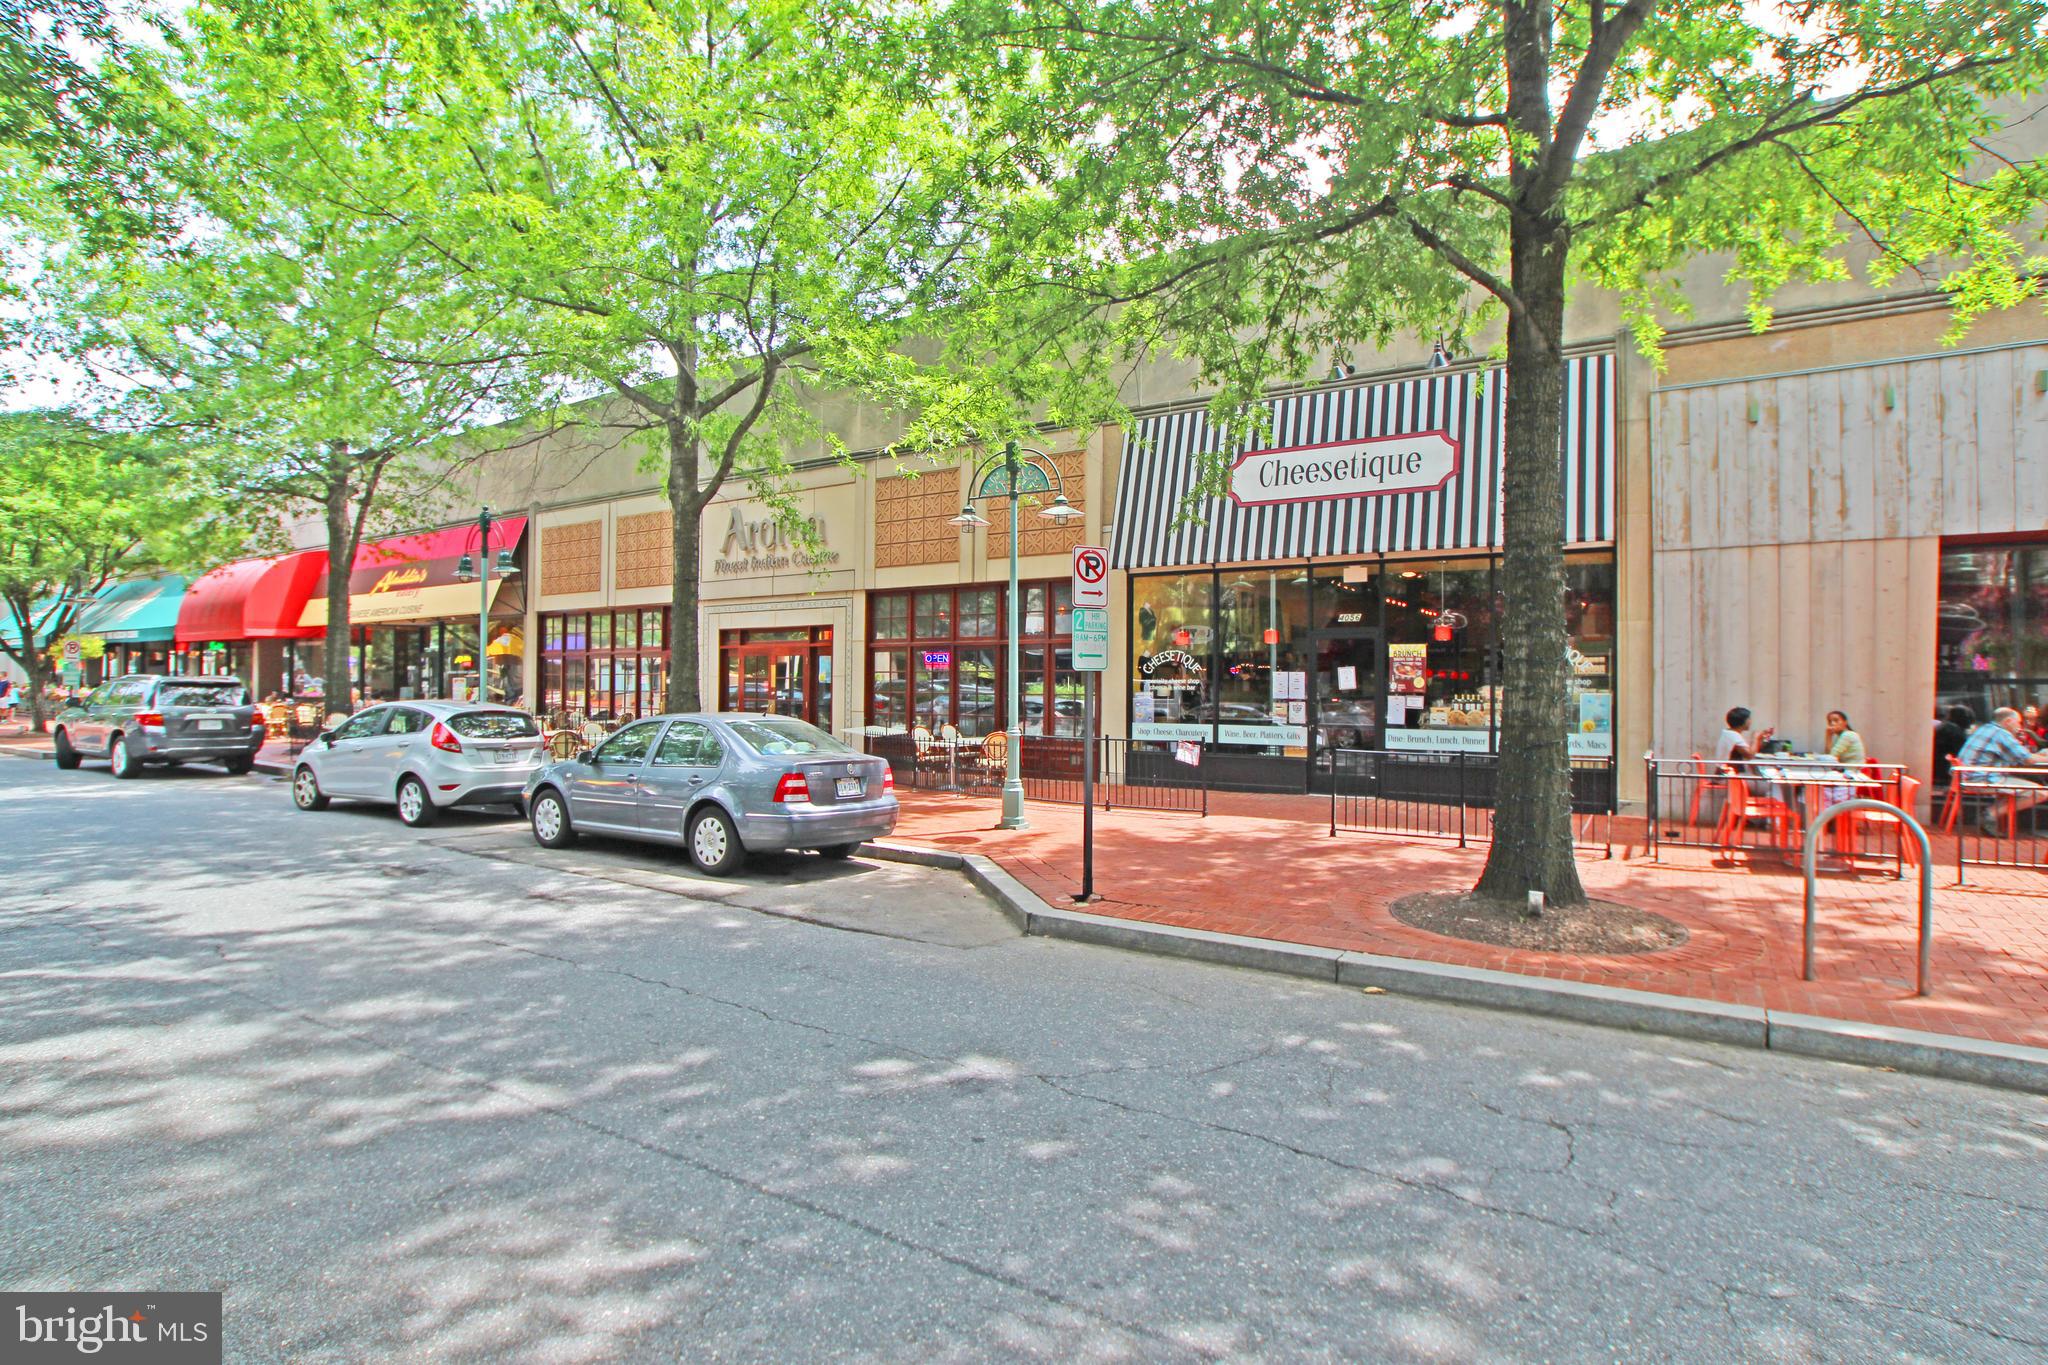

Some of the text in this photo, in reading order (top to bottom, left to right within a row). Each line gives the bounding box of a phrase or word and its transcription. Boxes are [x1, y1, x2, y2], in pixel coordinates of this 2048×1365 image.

[1259, 451, 1422, 487] Cheesetique
[714, 558, 749, 575] Finest
[751, 554, 790, 573] Indian
[1075, 611, 1084, 630] 2
[1085, 622, 1107, 630] PARKING
[925, 654, 949, 663] OPEN
[1393, 650, 1422, 658] BRUNCH
[1143, 649, 1203, 674] CHEESETIQUE
[1175, 728, 1209, 738] Charcuterie
[1462, 736, 1486, 745] Dinner
[1586, 740, 1607, 749] Macs
